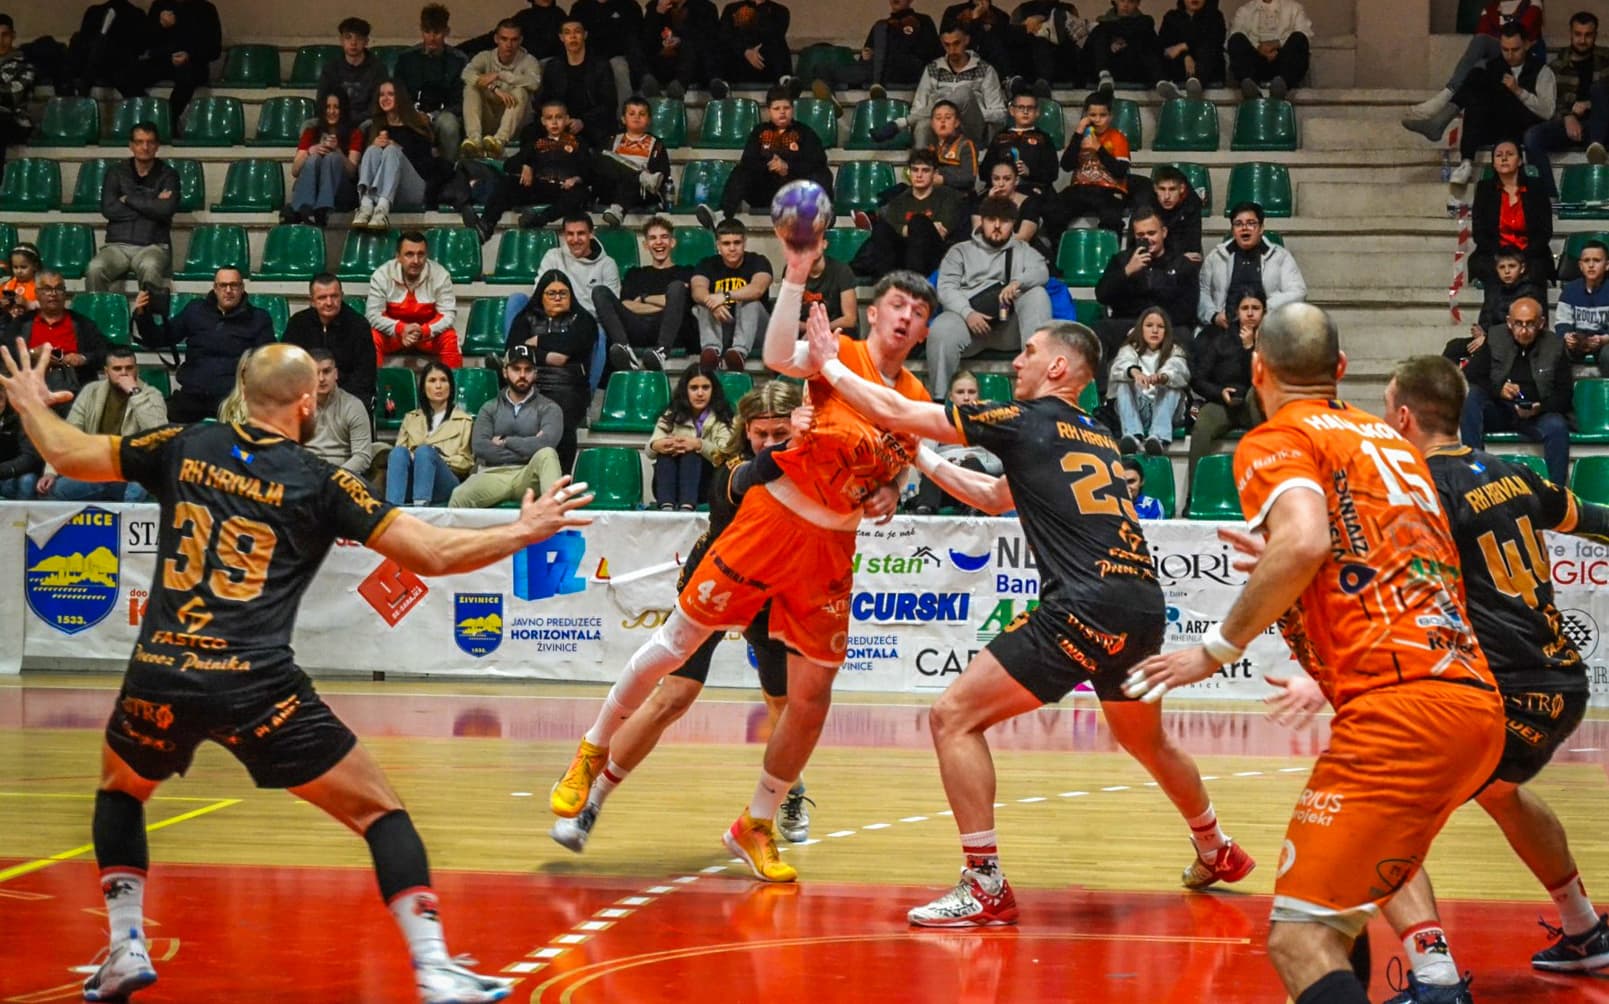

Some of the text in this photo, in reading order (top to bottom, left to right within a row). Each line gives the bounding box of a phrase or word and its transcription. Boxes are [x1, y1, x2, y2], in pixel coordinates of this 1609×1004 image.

[1360, 440, 1441, 516] 15
[162, 501, 278, 602] 39
[866, 554, 923, 574] stan
[696, 579, 732, 612] 44
[849, 592, 970, 621] CURSKI
[511, 618, 544, 627] JAVNO
[1185, 620, 1218, 634] ARZ
[511, 630, 601, 641] HORIZONTALA
